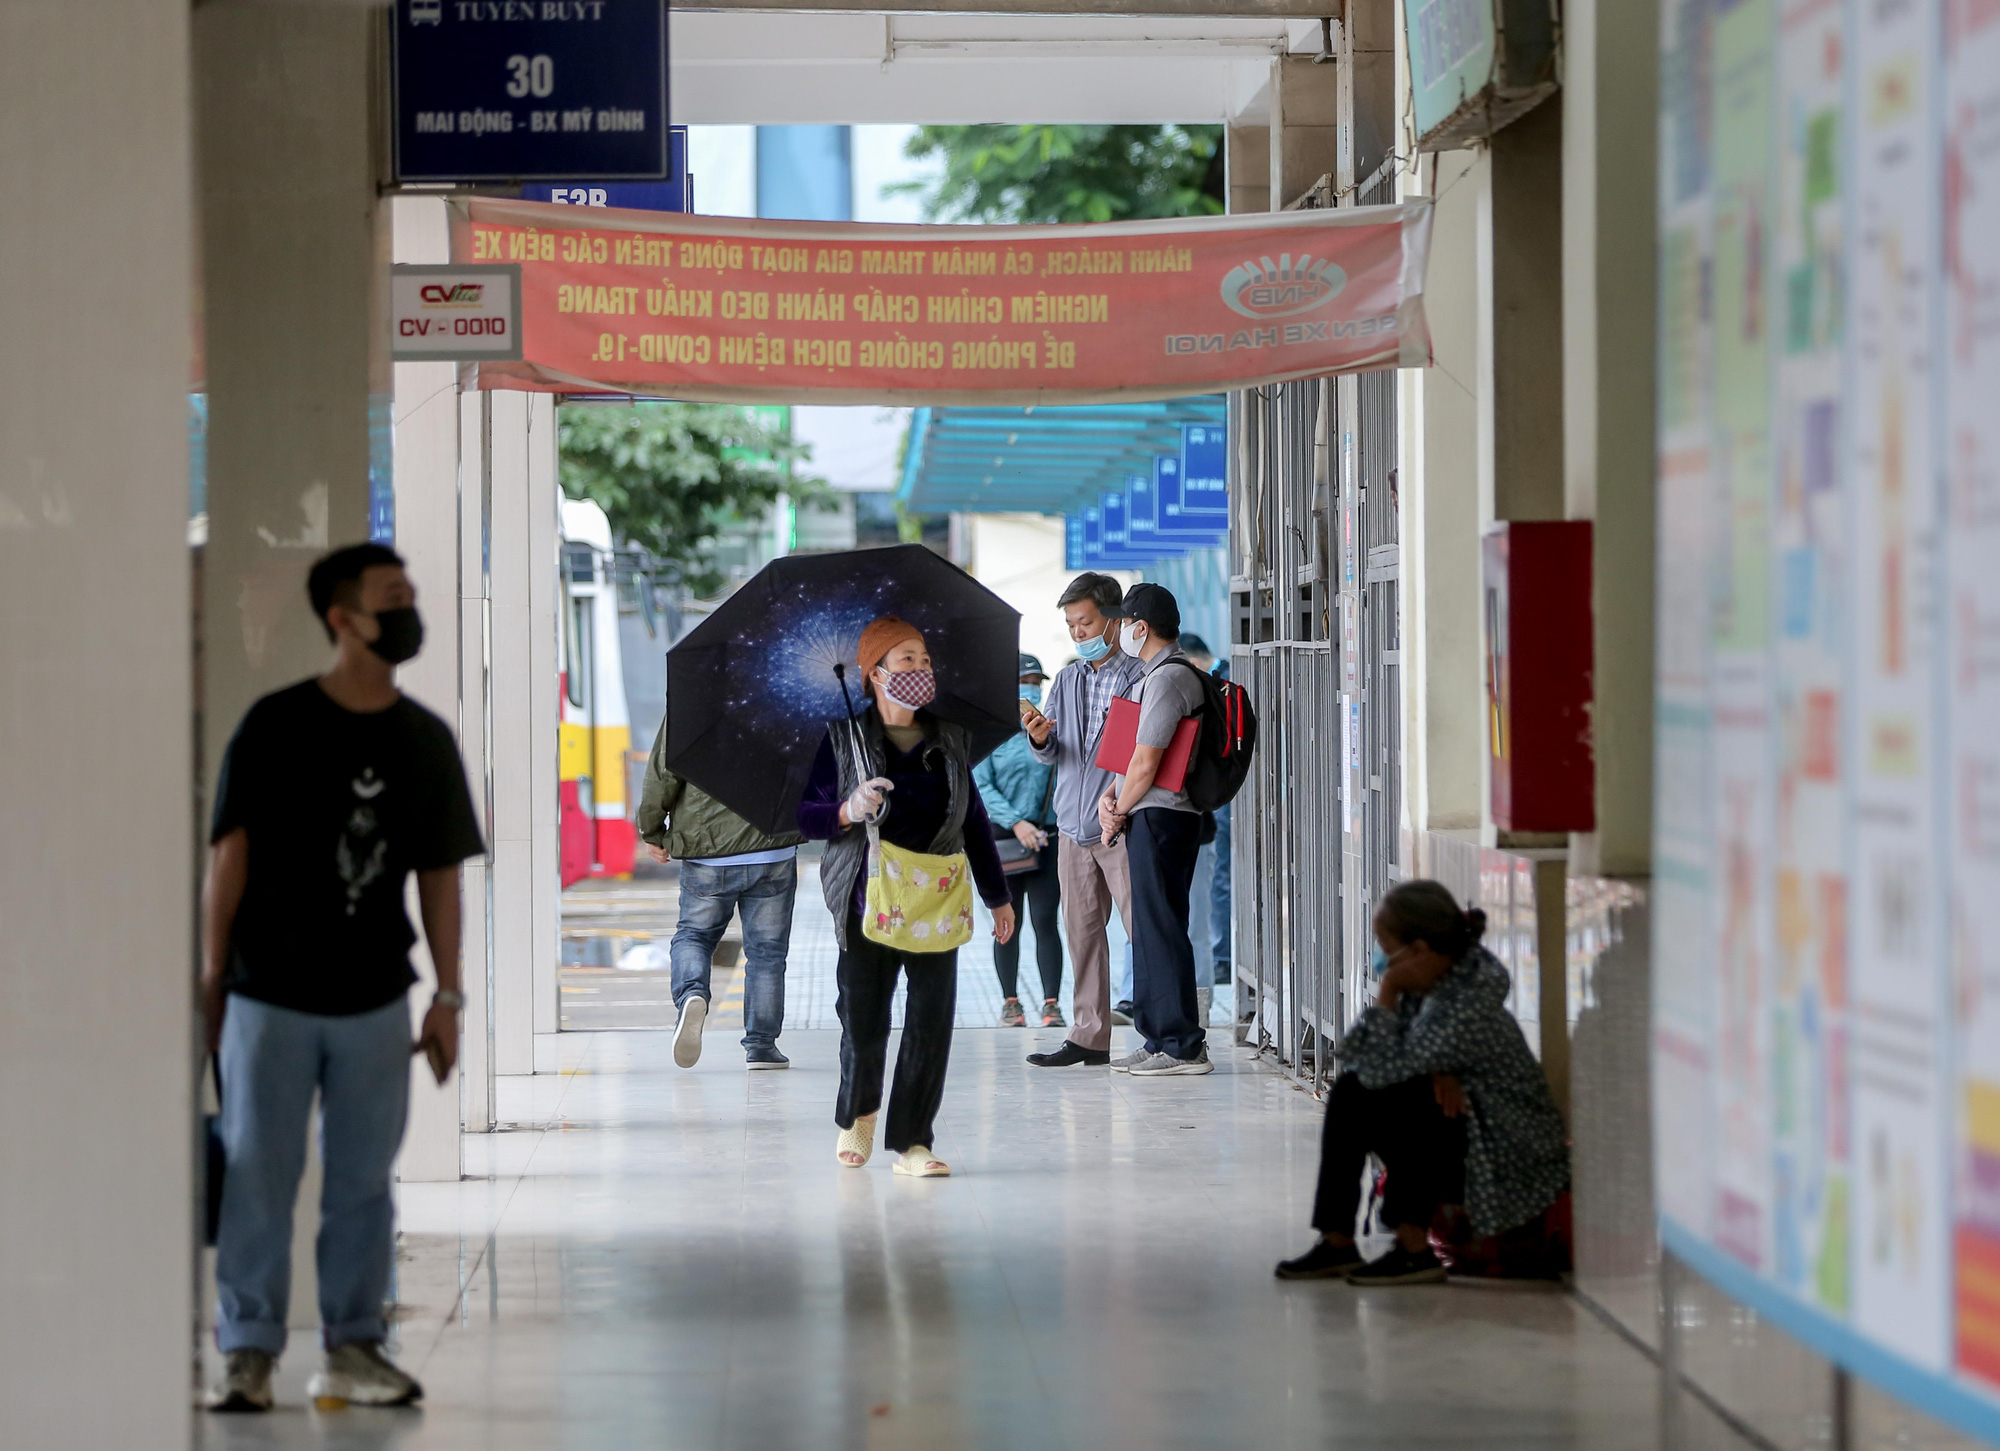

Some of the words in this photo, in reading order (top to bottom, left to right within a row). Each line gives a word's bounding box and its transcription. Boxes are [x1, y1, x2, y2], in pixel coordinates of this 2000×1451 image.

[506, 54, 554, 98] 30
[416, 111, 454, 133] MAI
[459, 107, 513, 137] ĐỘNG
[530, 111, 558, 133] BX
[562, 107, 593, 133] MỸ
[400, 318, 431, 337] CV
[454, 317, 506, 336] 0010
